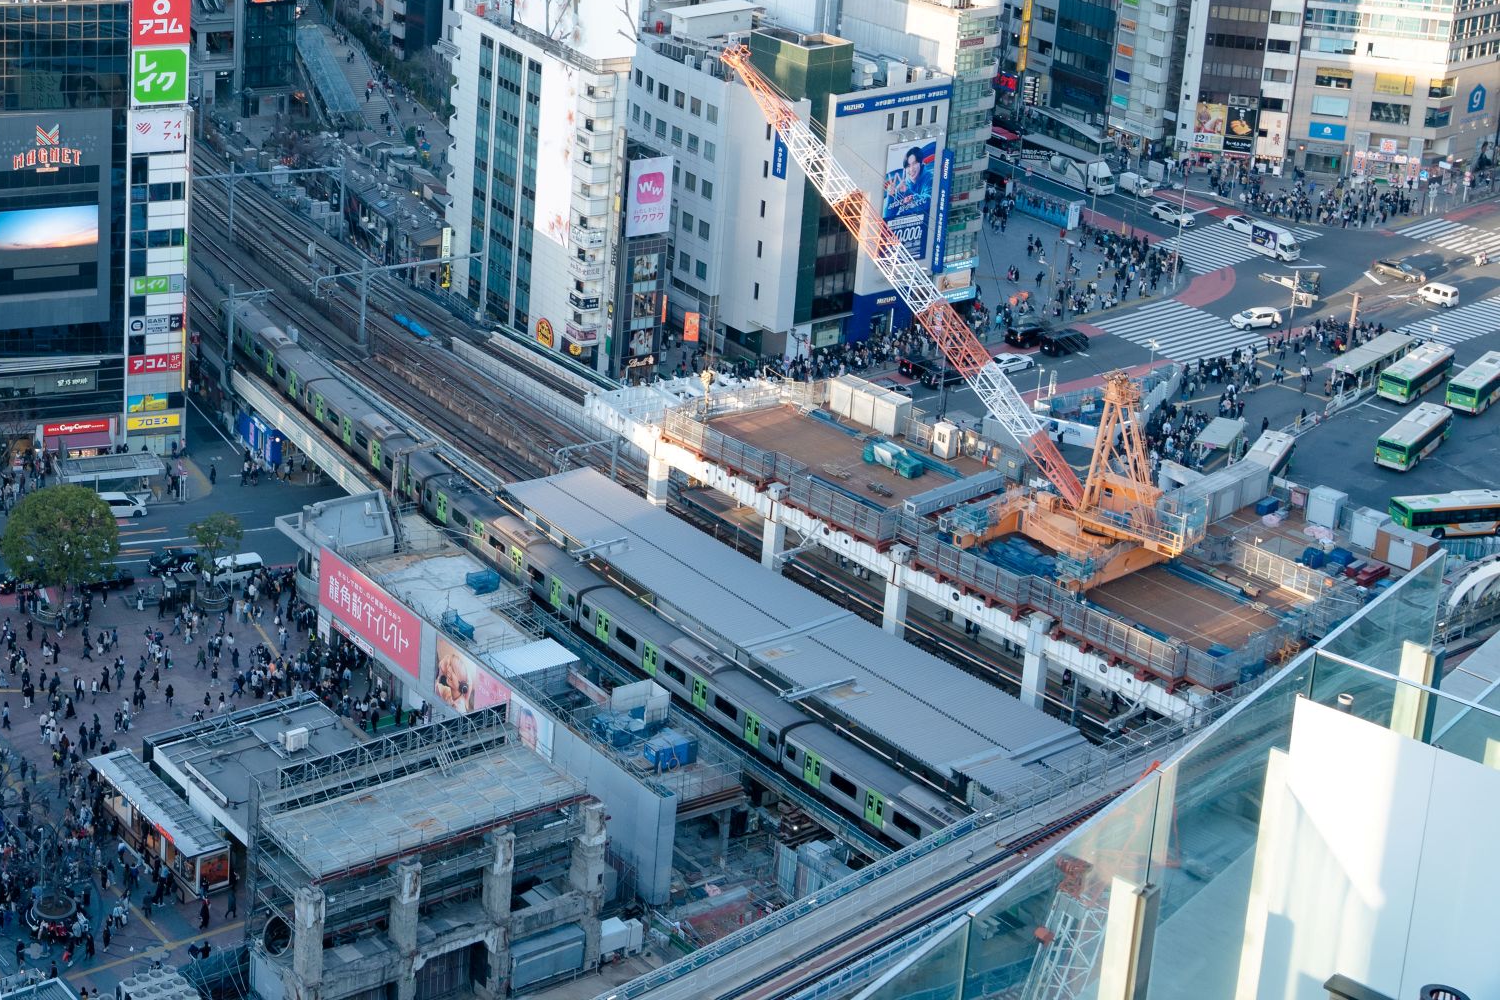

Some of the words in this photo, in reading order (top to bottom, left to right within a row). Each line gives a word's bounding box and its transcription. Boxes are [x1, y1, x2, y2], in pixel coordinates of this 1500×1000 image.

[139, 18, 184, 35] アコム
[843, 104, 866, 112] MIZUHO
[13, 148, 82, 170] MAGNET
[633, 213, 664, 223] ワクワク
[137, 278, 166, 290] レイク
[134, 358, 167, 370] アコム
[138, 417, 168, 426] プロミス
[329, 576, 410, 653] 龍角散ダイレクト
